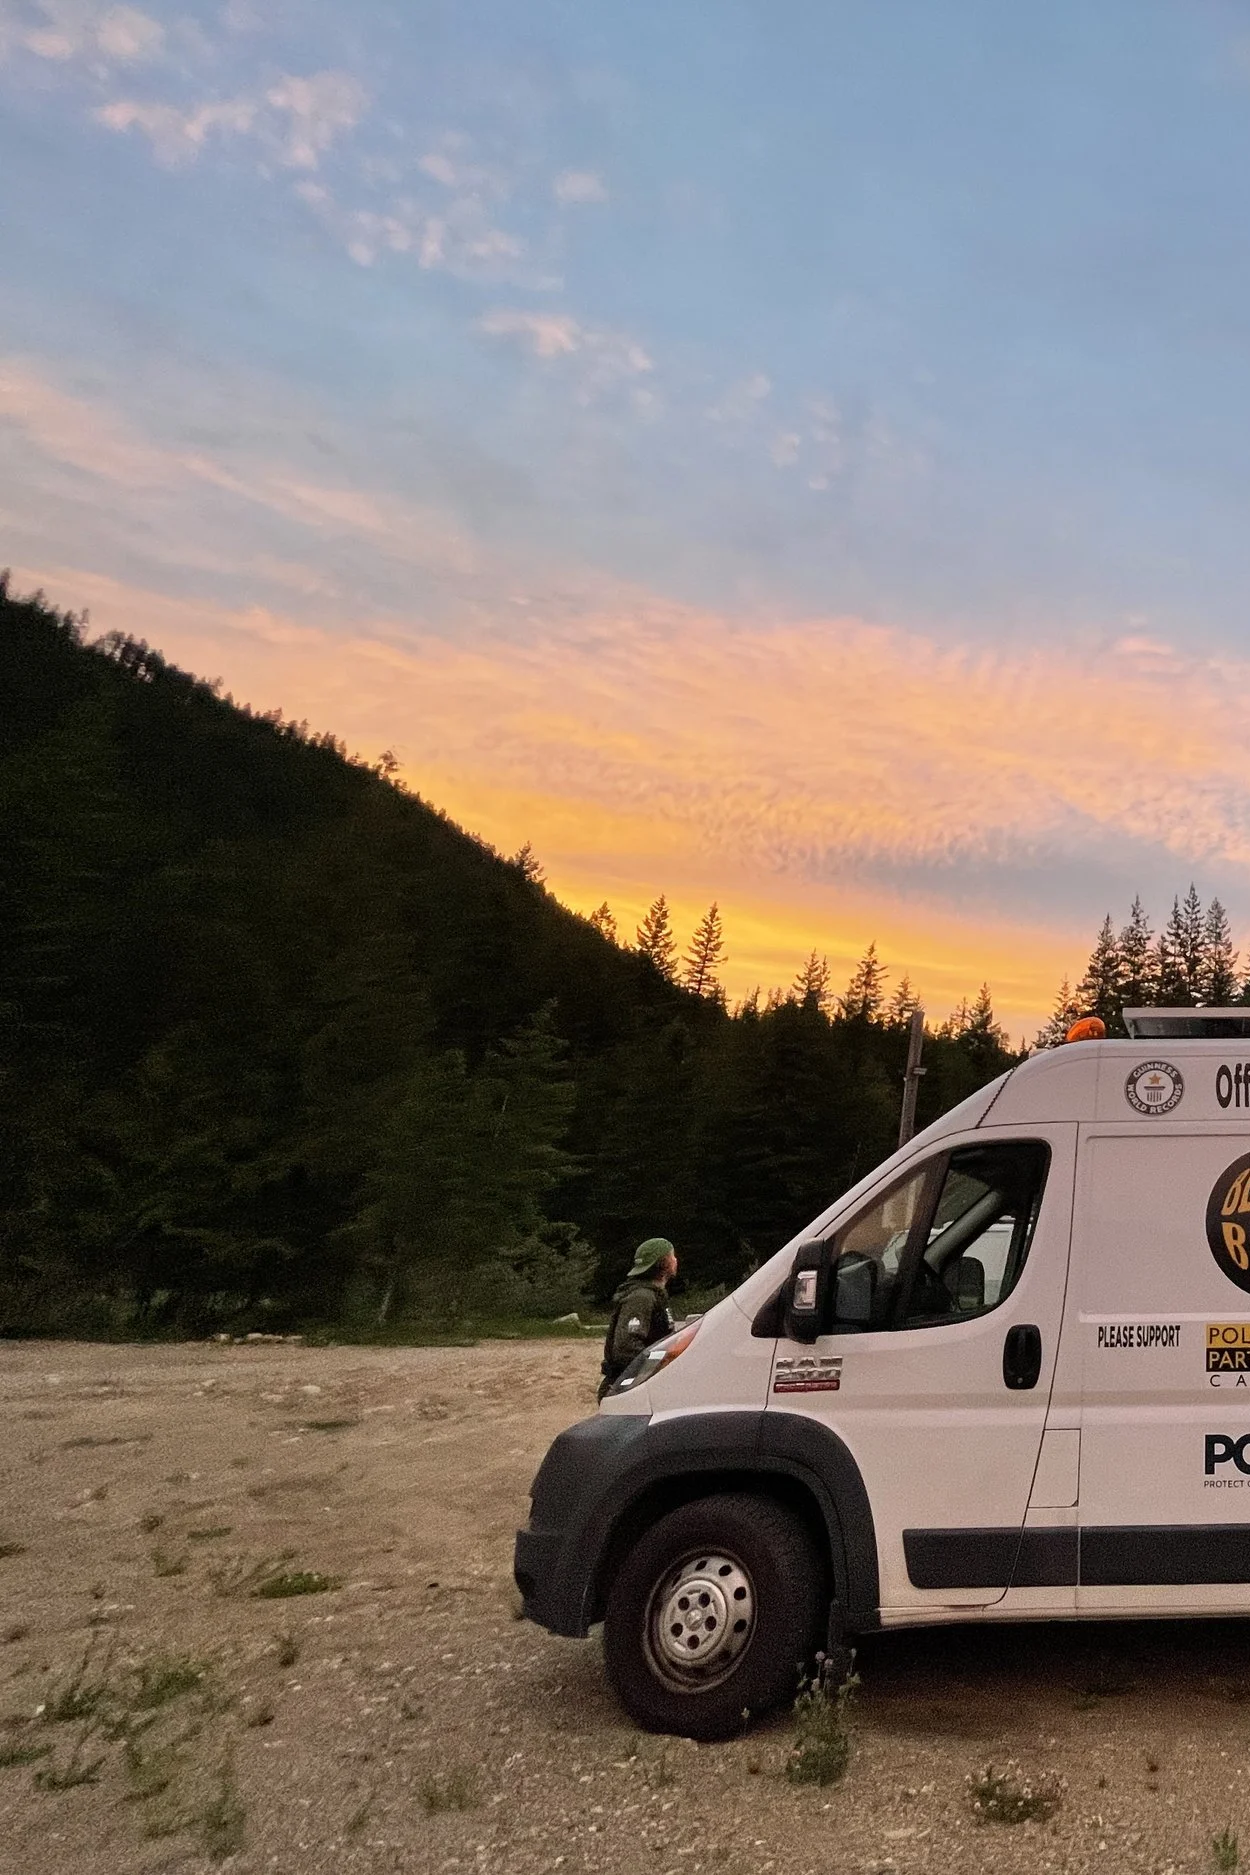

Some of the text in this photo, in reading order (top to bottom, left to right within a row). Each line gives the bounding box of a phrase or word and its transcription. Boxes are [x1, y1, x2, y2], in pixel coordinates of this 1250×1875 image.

[1133, 1063, 1178, 1078] GUINNESS
[1127, 1083, 1183, 1114] WORLD RECORDS
[1097, 1324, 1181, 1348] PLEASE SUPPORT
[1203, 1479, 1244, 1489] PROTECT
